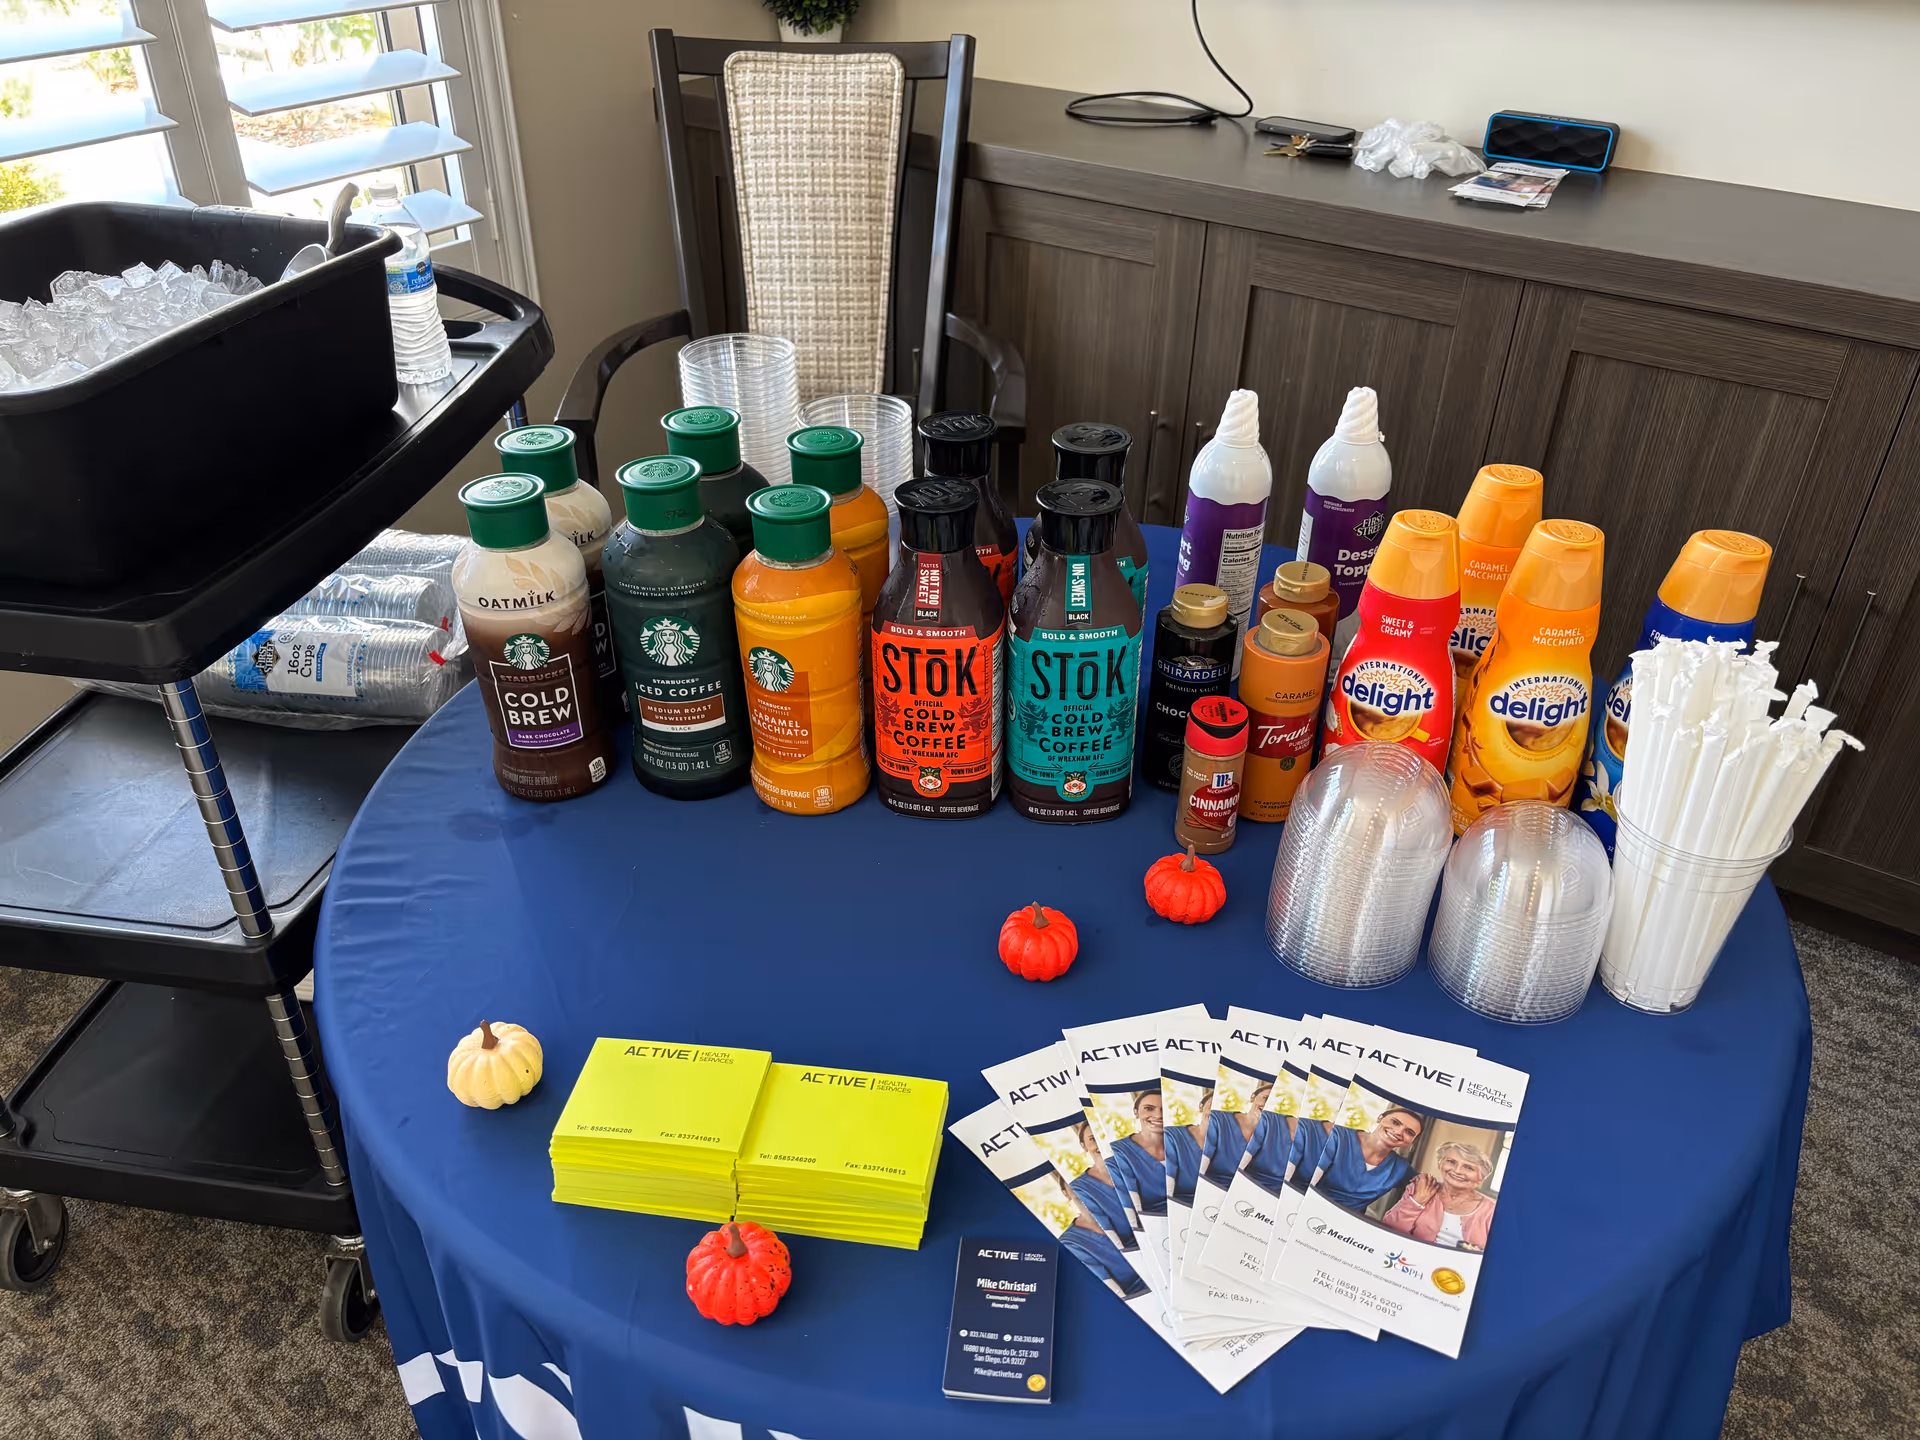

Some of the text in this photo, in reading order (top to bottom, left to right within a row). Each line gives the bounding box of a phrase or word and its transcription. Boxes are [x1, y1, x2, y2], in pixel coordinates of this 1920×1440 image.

[1362, 513, 1385, 528] FIRST
[1356, 520, 1384, 537] STREET
[1226, 531, 1253, 540] Nutrition
[1222, 556, 1250, 564] Calories
[1470, 560, 1509, 573] CARAMEL
[1334, 564, 1369, 577] Topp
[918, 569, 930, 604] SWEET
[929, 569, 940, 605] NOT TOO
[1071, 563, 1086, 607] UN-SWEET
[478, 590, 556, 609] OATMILK
[629, 589, 648, 597] COFFEE
[1381, 614, 1414, 629] SWEET &
[891, 626, 914, 635] BOLD
[926, 629, 966, 637] SMOOTH
[1042, 632, 1066, 640] BOLD
[1079, 629, 1118, 640] SMOOTH
[1381, 625, 1413, 638] CREAMY
[1539, 627, 1581, 637] CARAMEL
[1450, 627, 1490, 658] elig
[1532, 636, 1585, 646] MACCHIATO
[255, 646, 266, 668] FIRST
[264, 643, 274, 674] STREET
[300, 644, 316, 678] Cups
[500, 668, 564, 682] STARBUCKS
[1158, 660, 1230, 680] GHIRARDELLI
[1357, 661, 1427, 688] INTERNATIONAL
[635, 680, 722, 697] ICED COFFEE
[1166, 682, 1197, 693] PREMIUM
[1510, 676, 1586, 695] INTERNATIONAL
[504, 687, 569, 708] COLD
[1275, 690, 1316, 700] CARAMEL
[1342, 672, 1434, 716] delight
[647, 704, 712, 714] MEDIUM ROAST
[758, 699, 788, 711] STARBUCKS
[1490, 692, 1588, 726] delight
[508, 703, 572, 726] BREW
[754, 709, 800, 728] CARAMEL
[904, 708, 955, 720] COLD
[1052, 712, 1103, 724] COLD
[752, 715, 809, 737] MACCHIATO
[904, 721, 956, 733] BREW
[1052, 724, 1104, 737] BREW
[534, 728, 570, 739] CHOCOLATE
[893, 730, 966, 750] COFFEE
[1258, 719, 1311, 749] Torani
[718, 743, 726, 751] 15
[1039, 734, 1113, 753] COFFEE
[1294, 742, 1310, 752] SAUCE
[912, 749, 945, 758] WREXHAM
[947, 751, 959, 759] AFC
[706, 759, 711, 768] L
[780, 787, 810, 799] BEVERAGE
[816, 788, 829, 796] 190
[957, 803, 979, 813] BEVERAGE
[1083, 803, 1120, 816] COFFEE BEVERAGE
[1165, 1038, 1222, 1054] ACTI
[1230, 1029, 1289, 1052] ACTI
[624, 1046, 692, 1060] ACTIVE
[1081, 1039, 1160, 1063] ACTIVE
[1321, 1038, 1365, 1059] ACT
[699, 1056, 734, 1064] SERVICES
[800, 1072, 908, 1088] ACTIVE HEALTH
[1368, 1049, 1507, 1098] ACTIVE HEALTH
[876, 1084, 912, 1094] SERVICES
[1466, 1087, 1512, 1108] SERVICES
[590, 1126, 633, 1134] 8585246200
[660, 1131, 721, 1143] Fax: 8337410813
[980, 1121, 1027, 1158] ACTI
[774, 1154, 817, 1164] 8585246200
[863, 1164, 906, 1175] 8337410813
[1327, 1228, 1375, 1254] Medicare
[977, 1249, 1019, 1260] ACTIVE
[1243, 1252, 1261, 1264] TEL:
[1239, 1259, 1259, 1272] FAX:
[1393, 1262, 1424, 1280] CDPH
[976, 1278, 1037, 1292] Mike Christati
[1316, 1269, 1403, 1311] TEL: (858) 524 6200
[985, 1294, 1010, 1302] Community
[1208, 1290, 1228, 1299] FAX:
[1312, 1277, 1396, 1317] FAX: (833) 741 0813
[974, 1353, 984, 1361] San
[985, 1346, 1010, 1356] Bernardo
[1010, 1349, 1018, 1357] Dr.
[1018, 1350, 1029, 1358] STE
[1230, 1343, 1248, 1358] FAX:
[973, 1367, 1023, 1379] Mike@activehs.co
